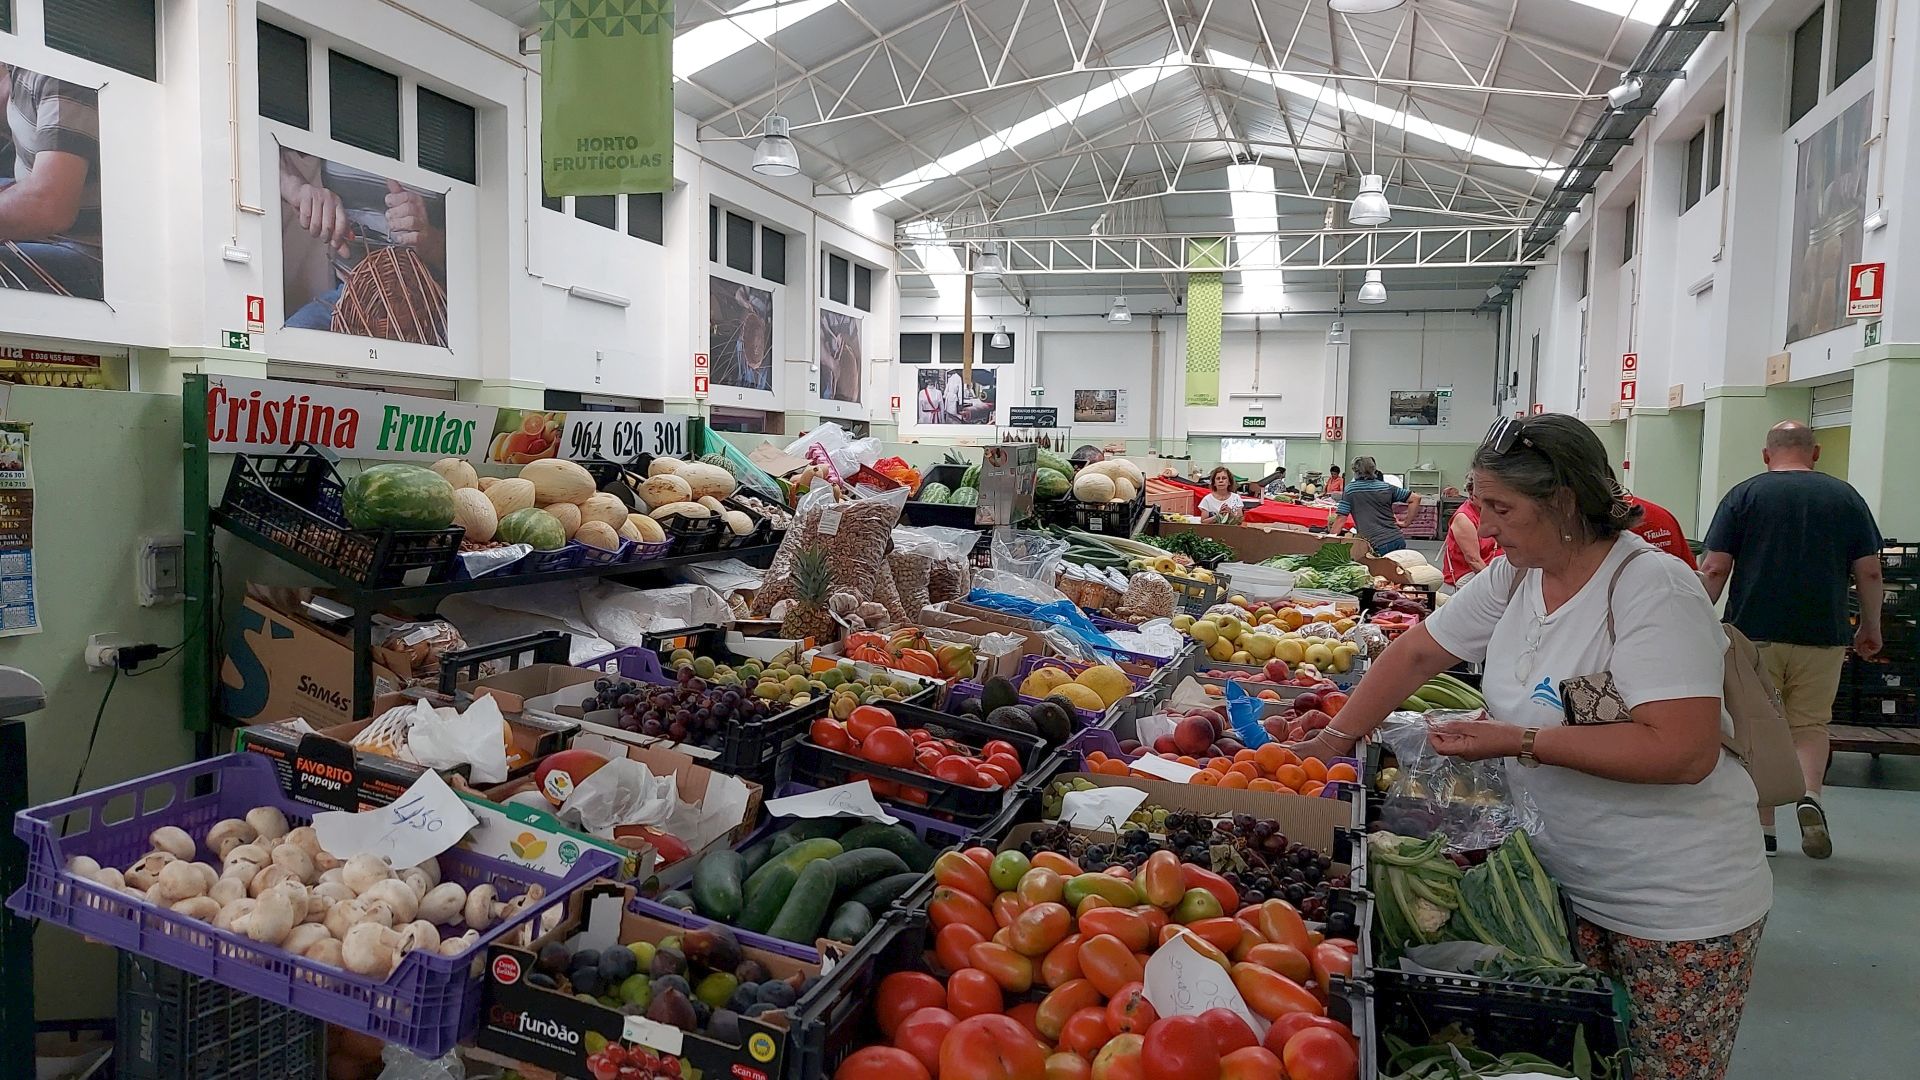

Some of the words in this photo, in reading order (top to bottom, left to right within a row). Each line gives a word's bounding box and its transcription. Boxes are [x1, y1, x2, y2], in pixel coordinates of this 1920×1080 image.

[577, 136, 639, 152] HORTO
[552, 153, 662, 171] FRUTÍCOLAS
[369, 348, 378, 360] 21
[207, 387, 360, 449] Cristina
[376, 404, 477, 455] Frutas
[569, 421, 602, 458] 964
[613, 421, 643, 456] 626
[654, 421, 683, 455] 301
[296, 757, 353, 783] FAVORITO
[301, 772, 342, 791] papaya
[731, 1063, 751, 1079] Scan
[752, 1071, 767, 1080] me
